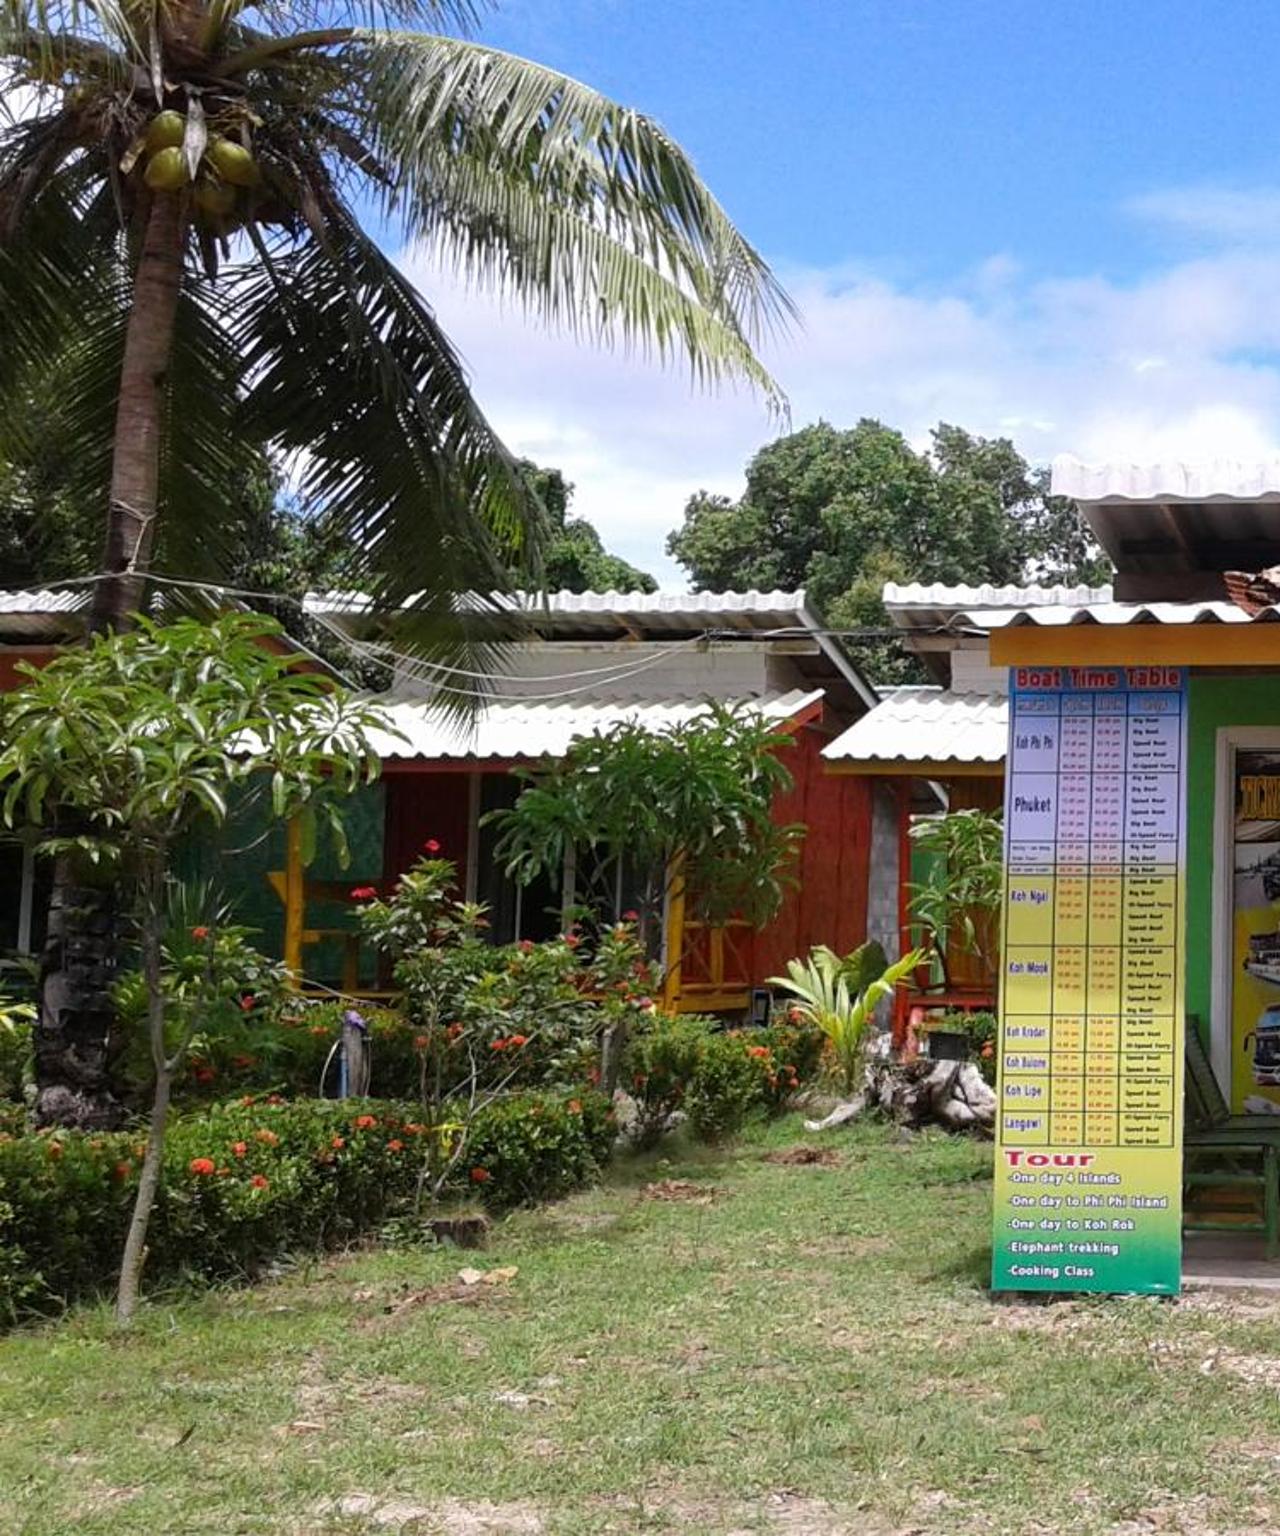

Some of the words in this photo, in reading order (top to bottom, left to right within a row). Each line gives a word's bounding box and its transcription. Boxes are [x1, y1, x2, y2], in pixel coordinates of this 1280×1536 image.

[1016, 667, 1061, 688] Boat
[1070, 667, 1118, 688] Time
[1126, 666, 1179, 687] Table
[1014, 796, 1051, 812] Phuket
[1005, 1085, 1021, 1097] Koh
[1004, 1150, 1095, 1168] Tour
[1008, 1172, 1036, 1184] -One
[1040, 1173, 1062, 1187] day
[1066, 1173, 1075, 1184] 4
[1079, 1173, 1121, 1184] Islands
[1040, 1195, 1062, 1209] day
[1067, 1196, 1080, 1207] to
[1084, 1195, 1103, 1208] Phi
[1108, 1196, 1127, 1208] Phi
[1131, 1196, 1168, 1208] Island
[1008, 1219, 1035, 1230] -One
[1040, 1219, 1061, 1232] day
[1067, 1219, 1079, 1230] to
[1084, 1219, 1107, 1231] Koh
[1112, 1219, 1135, 1231] Rok
[1008, 1242, 1064, 1255] -Elephant
[1069, 1242, 1120, 1256] trekking
[1008, 1265, 1060, 1279] -Cooking
[1064, 1265, 1095, 1278] Class
